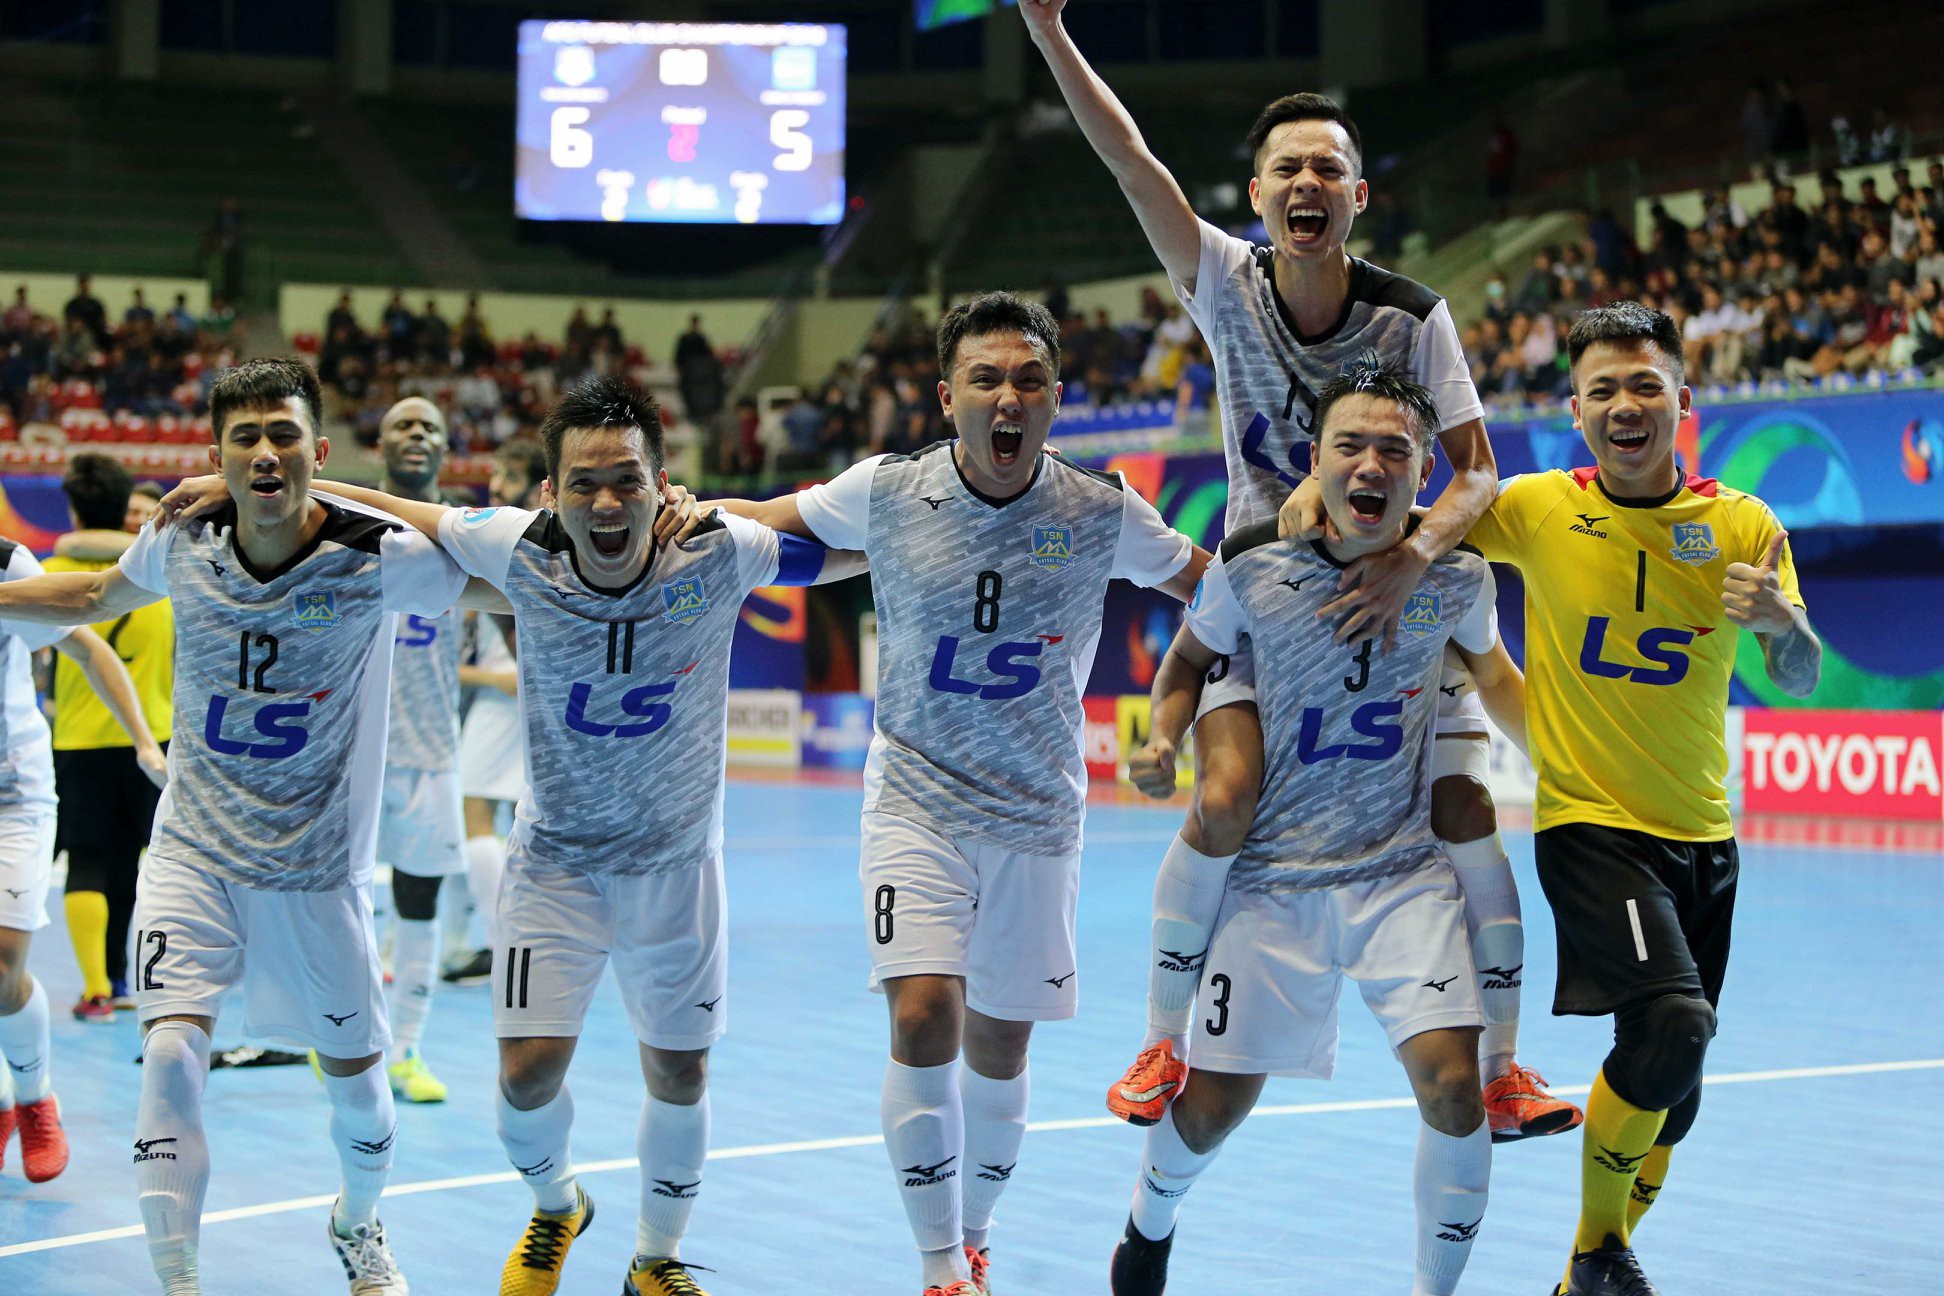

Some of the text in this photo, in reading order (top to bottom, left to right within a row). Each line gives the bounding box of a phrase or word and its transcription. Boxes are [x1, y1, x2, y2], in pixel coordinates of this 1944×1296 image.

[550, 107, 812, 171] 6 5
[1042, 531, 1064, 540] TSN
[1569, 524, 1607, 539] MIZUNO
[1681, 528, 1704, 536] TSN
[670, 583, 694, 596] TSN
[973, 570, 1003, 634] 8
[1412, 596, 1434, 606] TSN
[1636, 550, 1646, 613] 1
[239, 631, 279, 694] 12
[606, 621, 635, 674] 11
[928, 635, 1043, 700] LS
[1344, 635, 1372, 693] 3
[1579, 616, 1694, 686] LS
[205, 695, 310, 759] LS
[565, 682, 677, 738] LS
[1296, 700, 1404, 766] LS
[1745, 732, 1941, 797] TOYOTA
[874, 884, 895, 945] 8
[1625, 899, 1648, 962] 1
[135, 929, 167, 991] 12
[505, 947, 531, 1008] 11
[1205, 973, 1232, 1036] 3
[904, 1169, 956, 1187] MIZUNO
